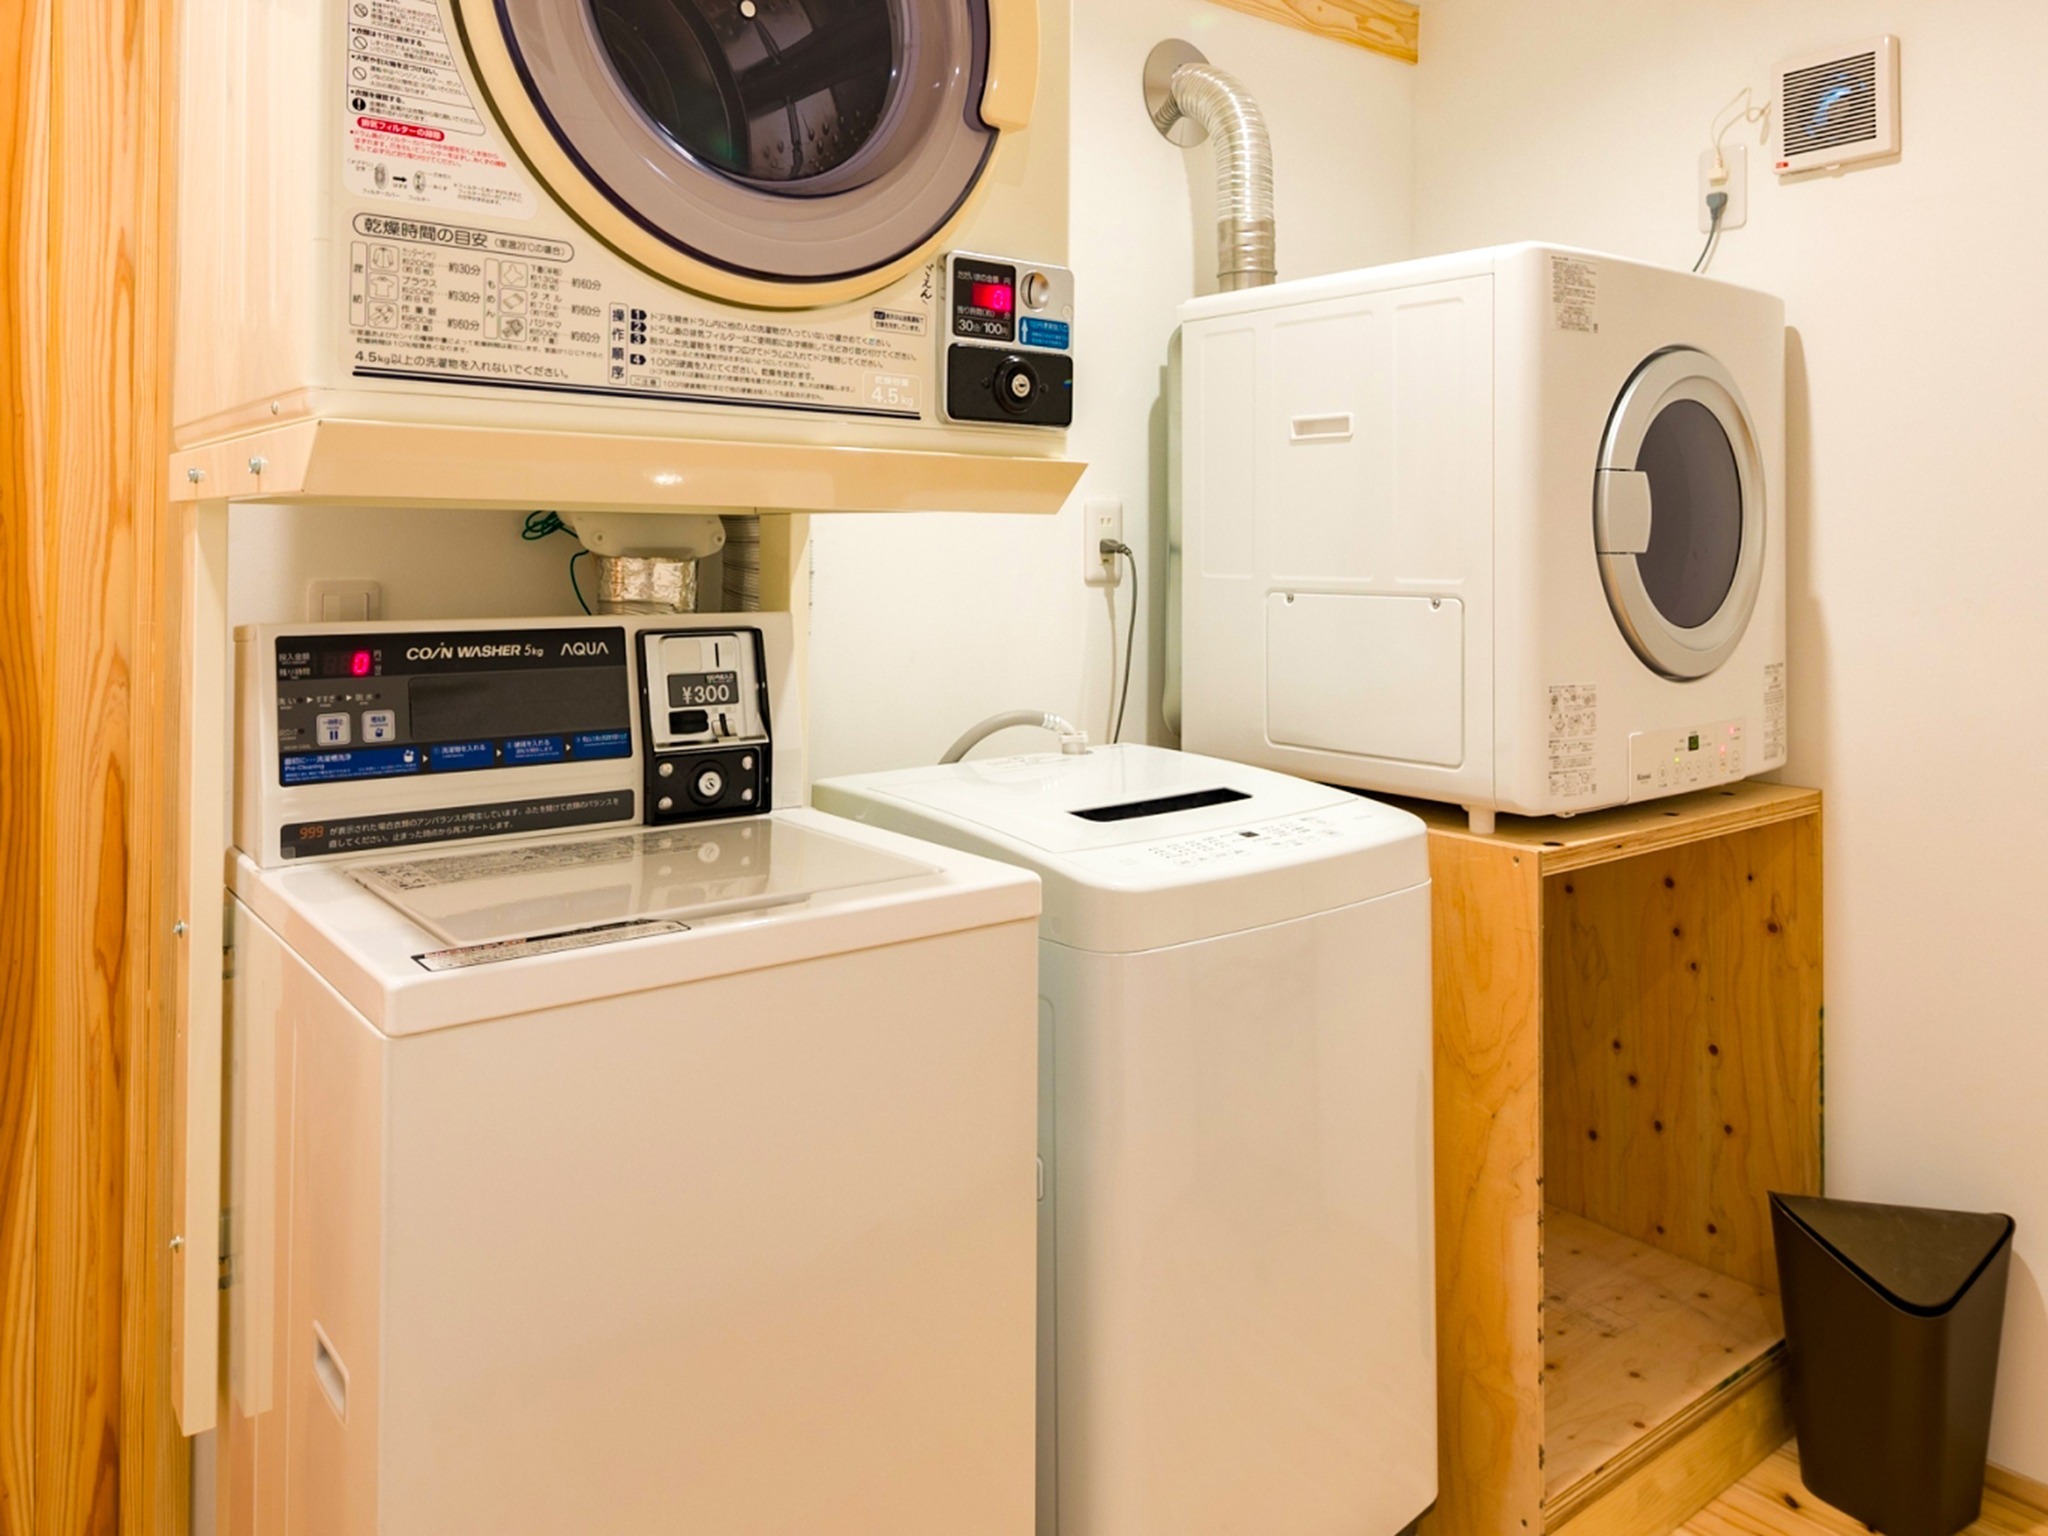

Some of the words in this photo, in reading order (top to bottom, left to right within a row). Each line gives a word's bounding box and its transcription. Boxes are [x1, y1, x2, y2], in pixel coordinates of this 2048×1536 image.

[363, 217, 488, 248] 乾燥時間の目安
[448, 262, 481, 277] 約30分
[402, 276, 437, 289] ブラウス
[447, 290, 480, 304] 約30分
[609, 308, 626, 380] 操作順序
[355, 350, 569, 379] 4.5kg以上の洗濯物を入れないでください。
[279, 652, 310, 661] 投入金額
[406, 642, 454, 661] COIN
[457, 644, 521, 659] WASHER
[524, 644, 544, 658] 5kg
[560, 641, 609, 657] AQUA
[352, 650, 370, 676] 0
[279, 667, 310, 676] 残り時間
[681, 684, 730, 705] ¥300
[441, 744, 487, 754] 洗濯物を入れる
[514, 739, 550, 749] 硬貨を入れる
[284, 763, 325, 771] Pre-Cleaning
[300, 825, 324, 840] 999
[329, 821, 515, 849] 直してください。止まった時点から再スタートします。
